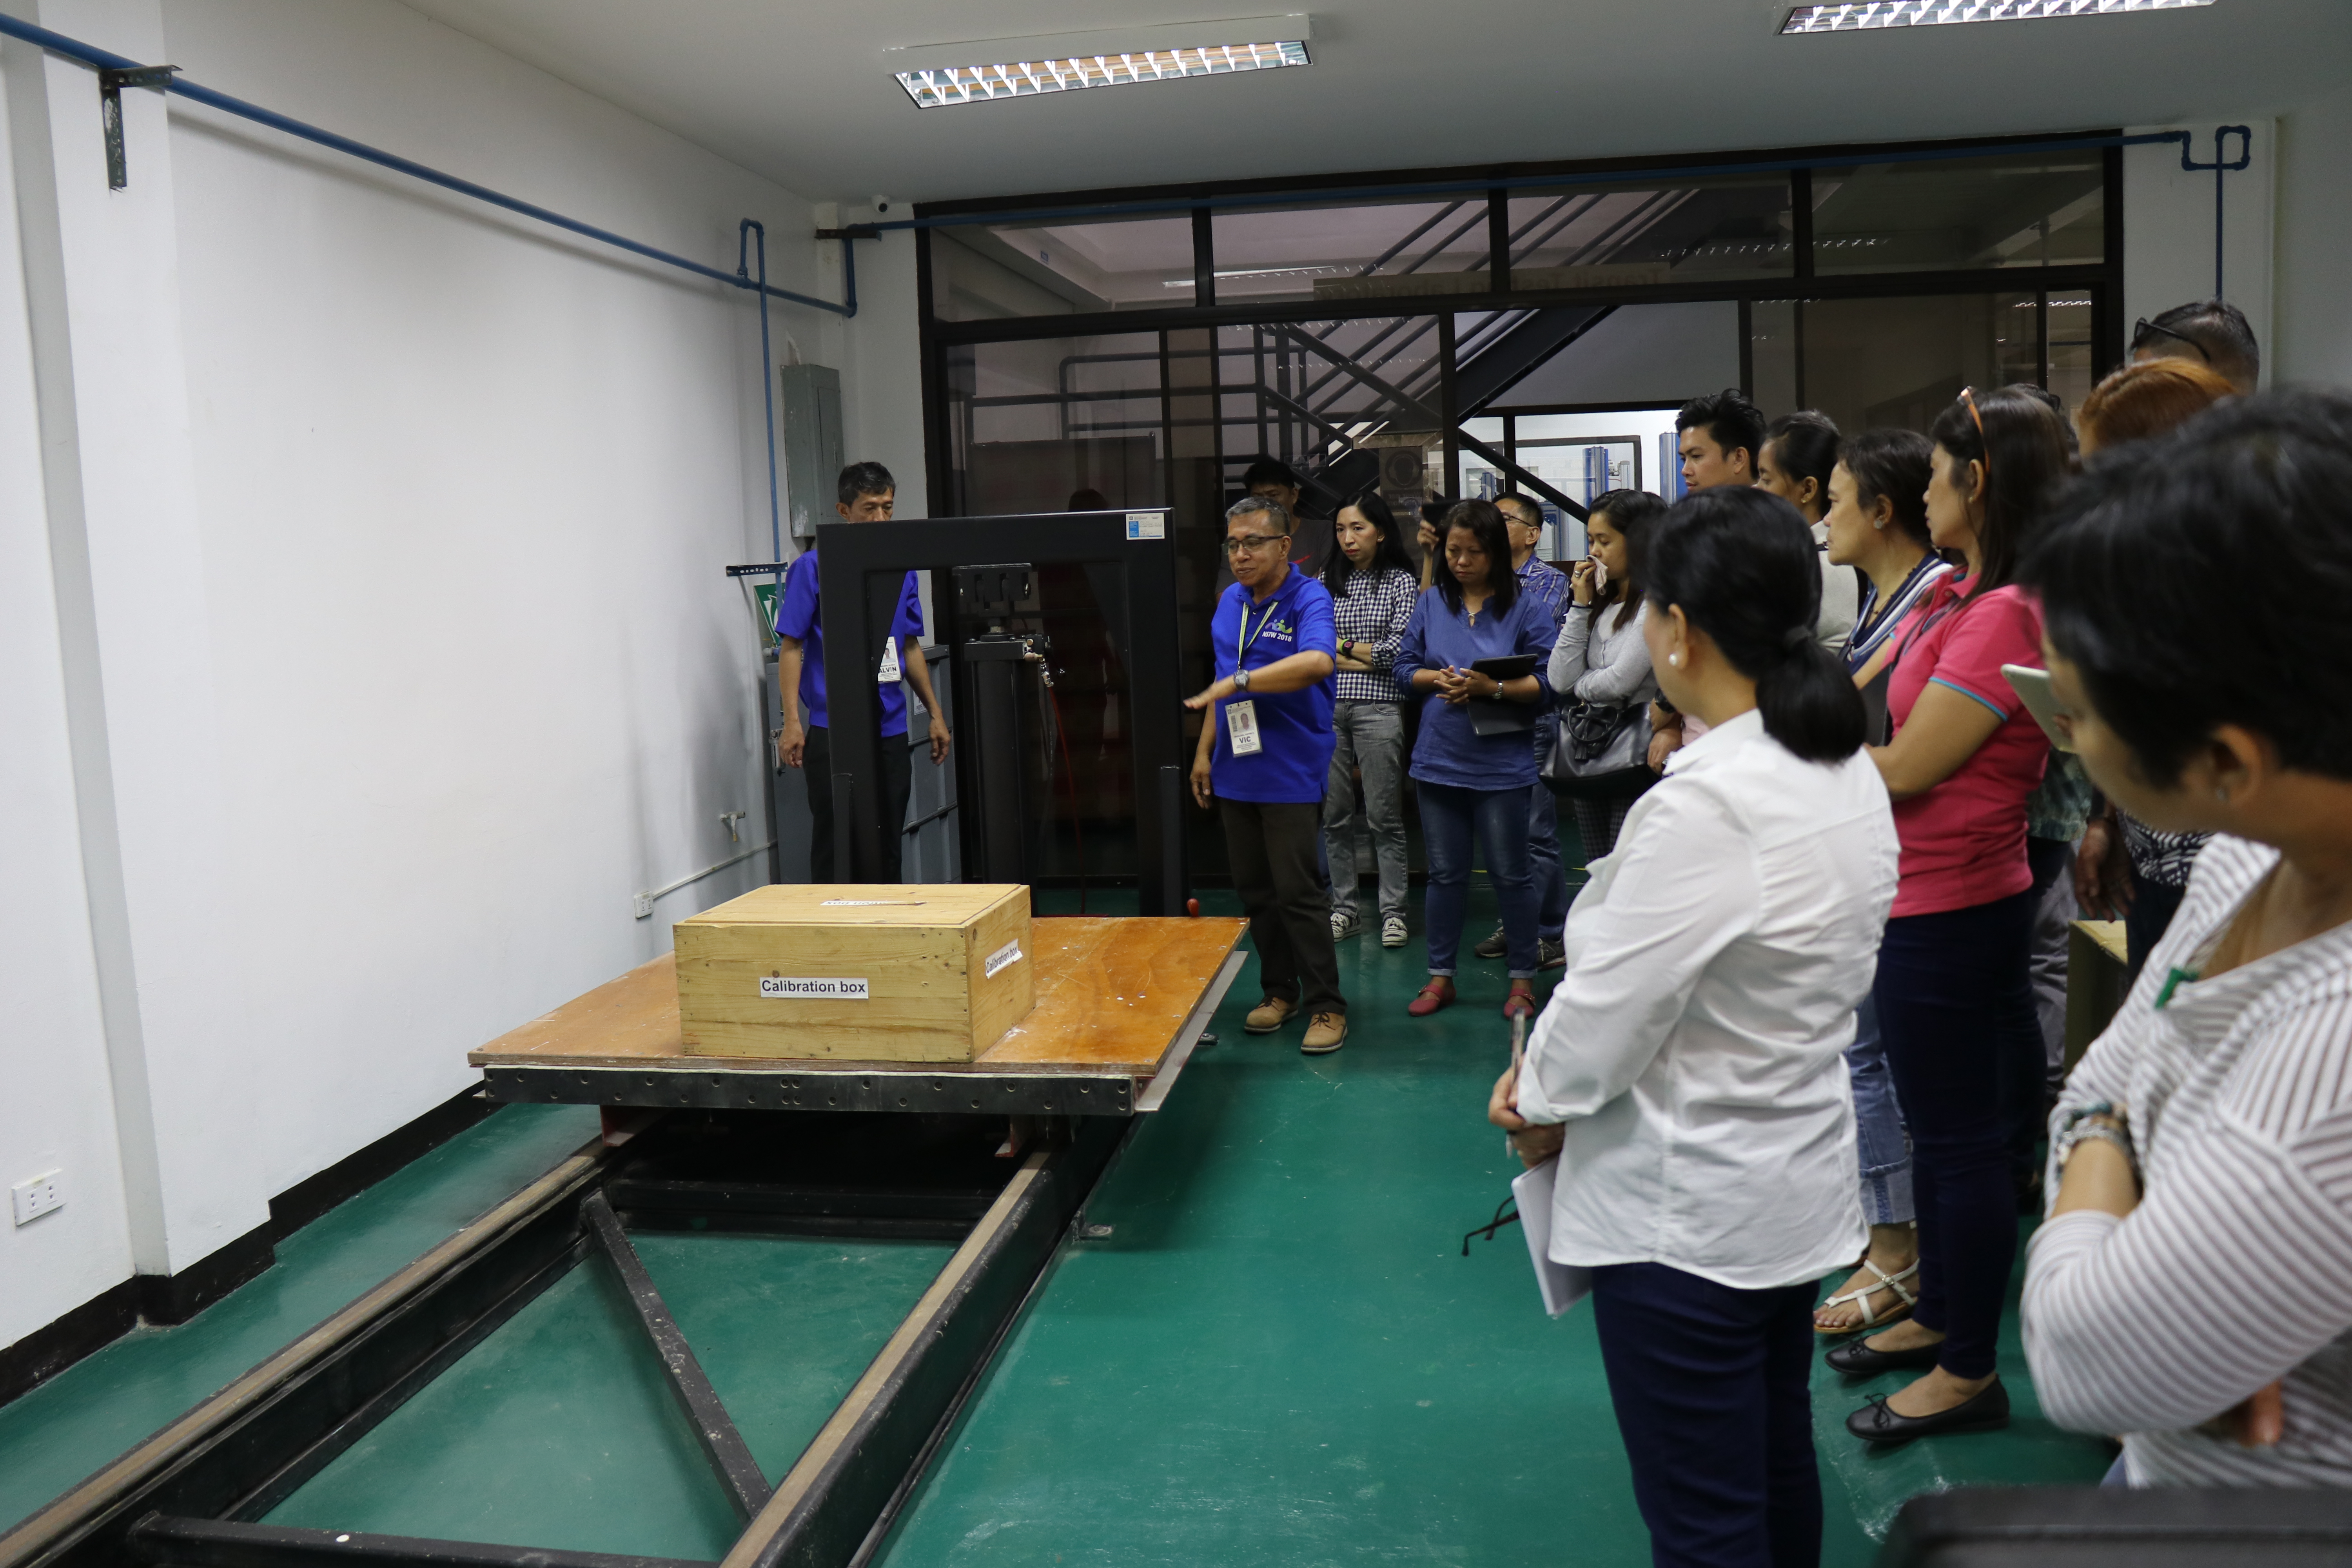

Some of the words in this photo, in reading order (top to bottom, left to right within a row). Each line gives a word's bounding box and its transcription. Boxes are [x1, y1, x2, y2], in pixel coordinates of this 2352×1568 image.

[1277, 633, 1292, 642] 2018
[1239, 736, 1251, 744] VIC
[987, 952, 1010, 973] Calibration
[1010, 946, 1018, 957] box
[762, 980, 835, 992] Calibration
[840, 981, 866, 993] box
